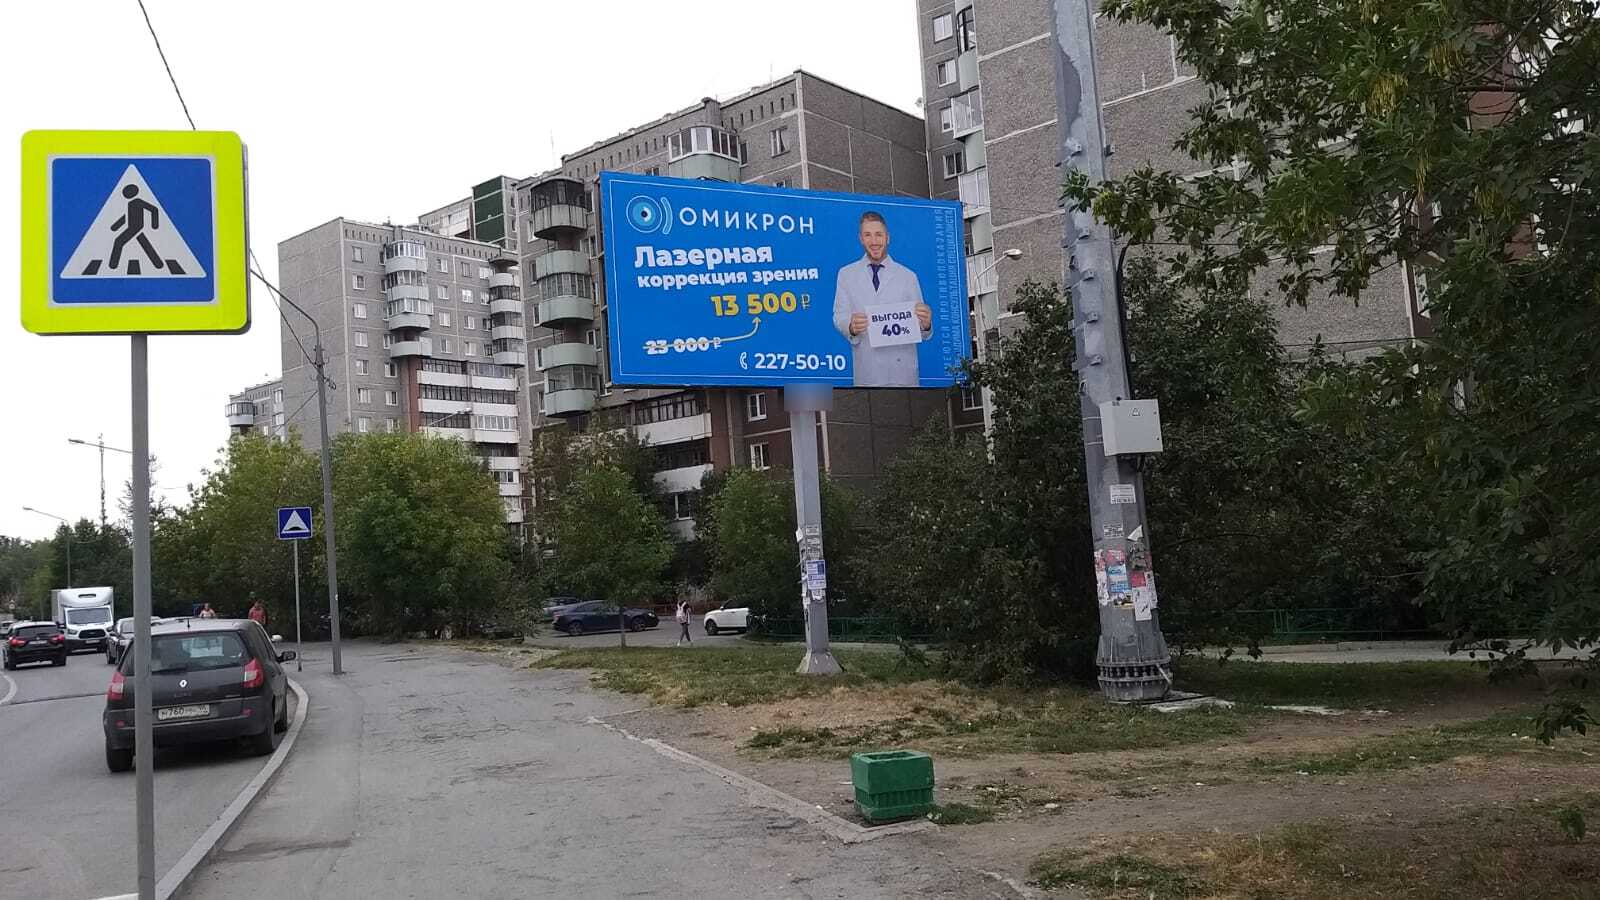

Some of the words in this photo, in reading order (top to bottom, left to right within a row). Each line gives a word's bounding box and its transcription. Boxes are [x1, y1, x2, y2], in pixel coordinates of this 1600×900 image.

[679, 206, 814, 235] ОМИКРОН
[634, 246, 773, 270] Лазерная
[637, 270, 748, 290] коррекция
[752, 267, 819, 286] зрения
[711, 295, 740, 316] 13
[747, 291, 797, 314] 500
[881, 323, 910, 336] 40%
[754, 353, 847, 371] 227-50-10
